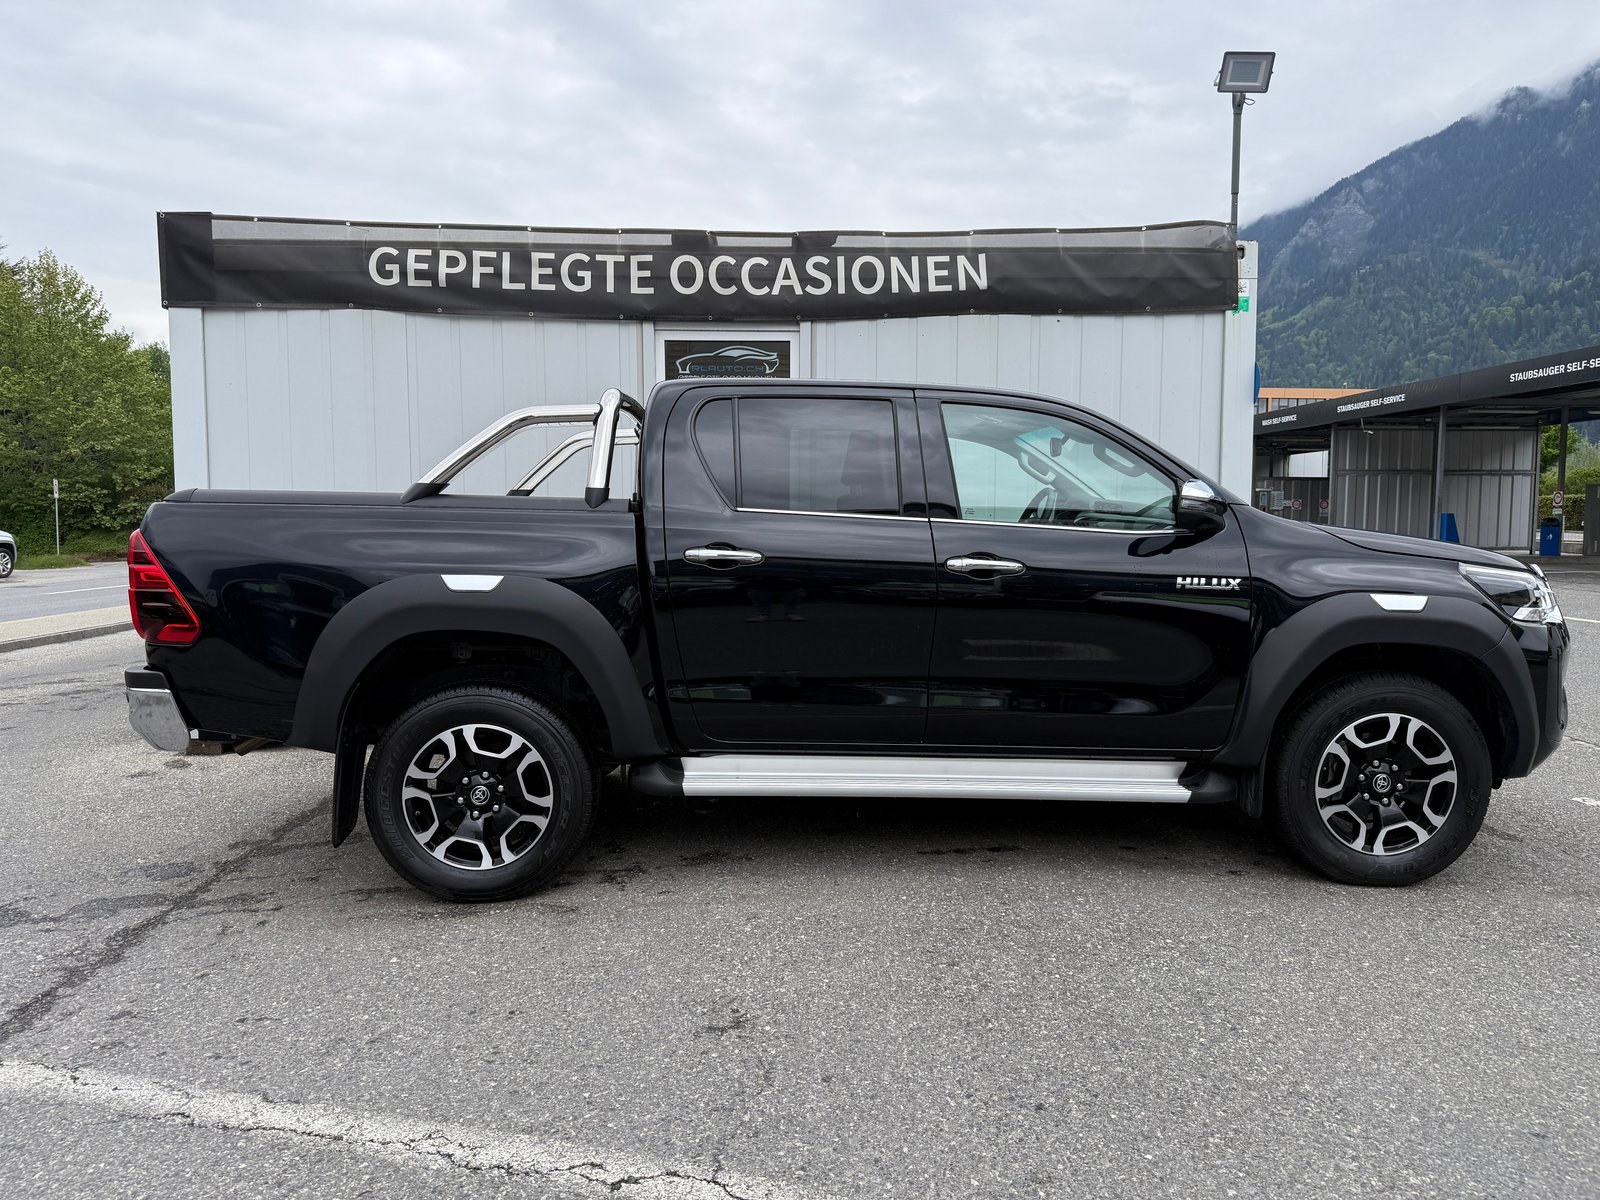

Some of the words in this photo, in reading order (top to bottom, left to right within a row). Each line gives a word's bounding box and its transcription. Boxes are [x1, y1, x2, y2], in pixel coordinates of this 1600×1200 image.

[368, 246, 655, 294] GEPFLEGTE
[669, 253, 988, 295] OCCASIONEN
[1510, 365, 1565, 382] STAUBSAUGER
[1337, 401, 1370, 413] STAUBSAUGER
[1370, 394, 1405, 407] SELF-SERVICE
[1176, 577, 1241, 590] HILUX
